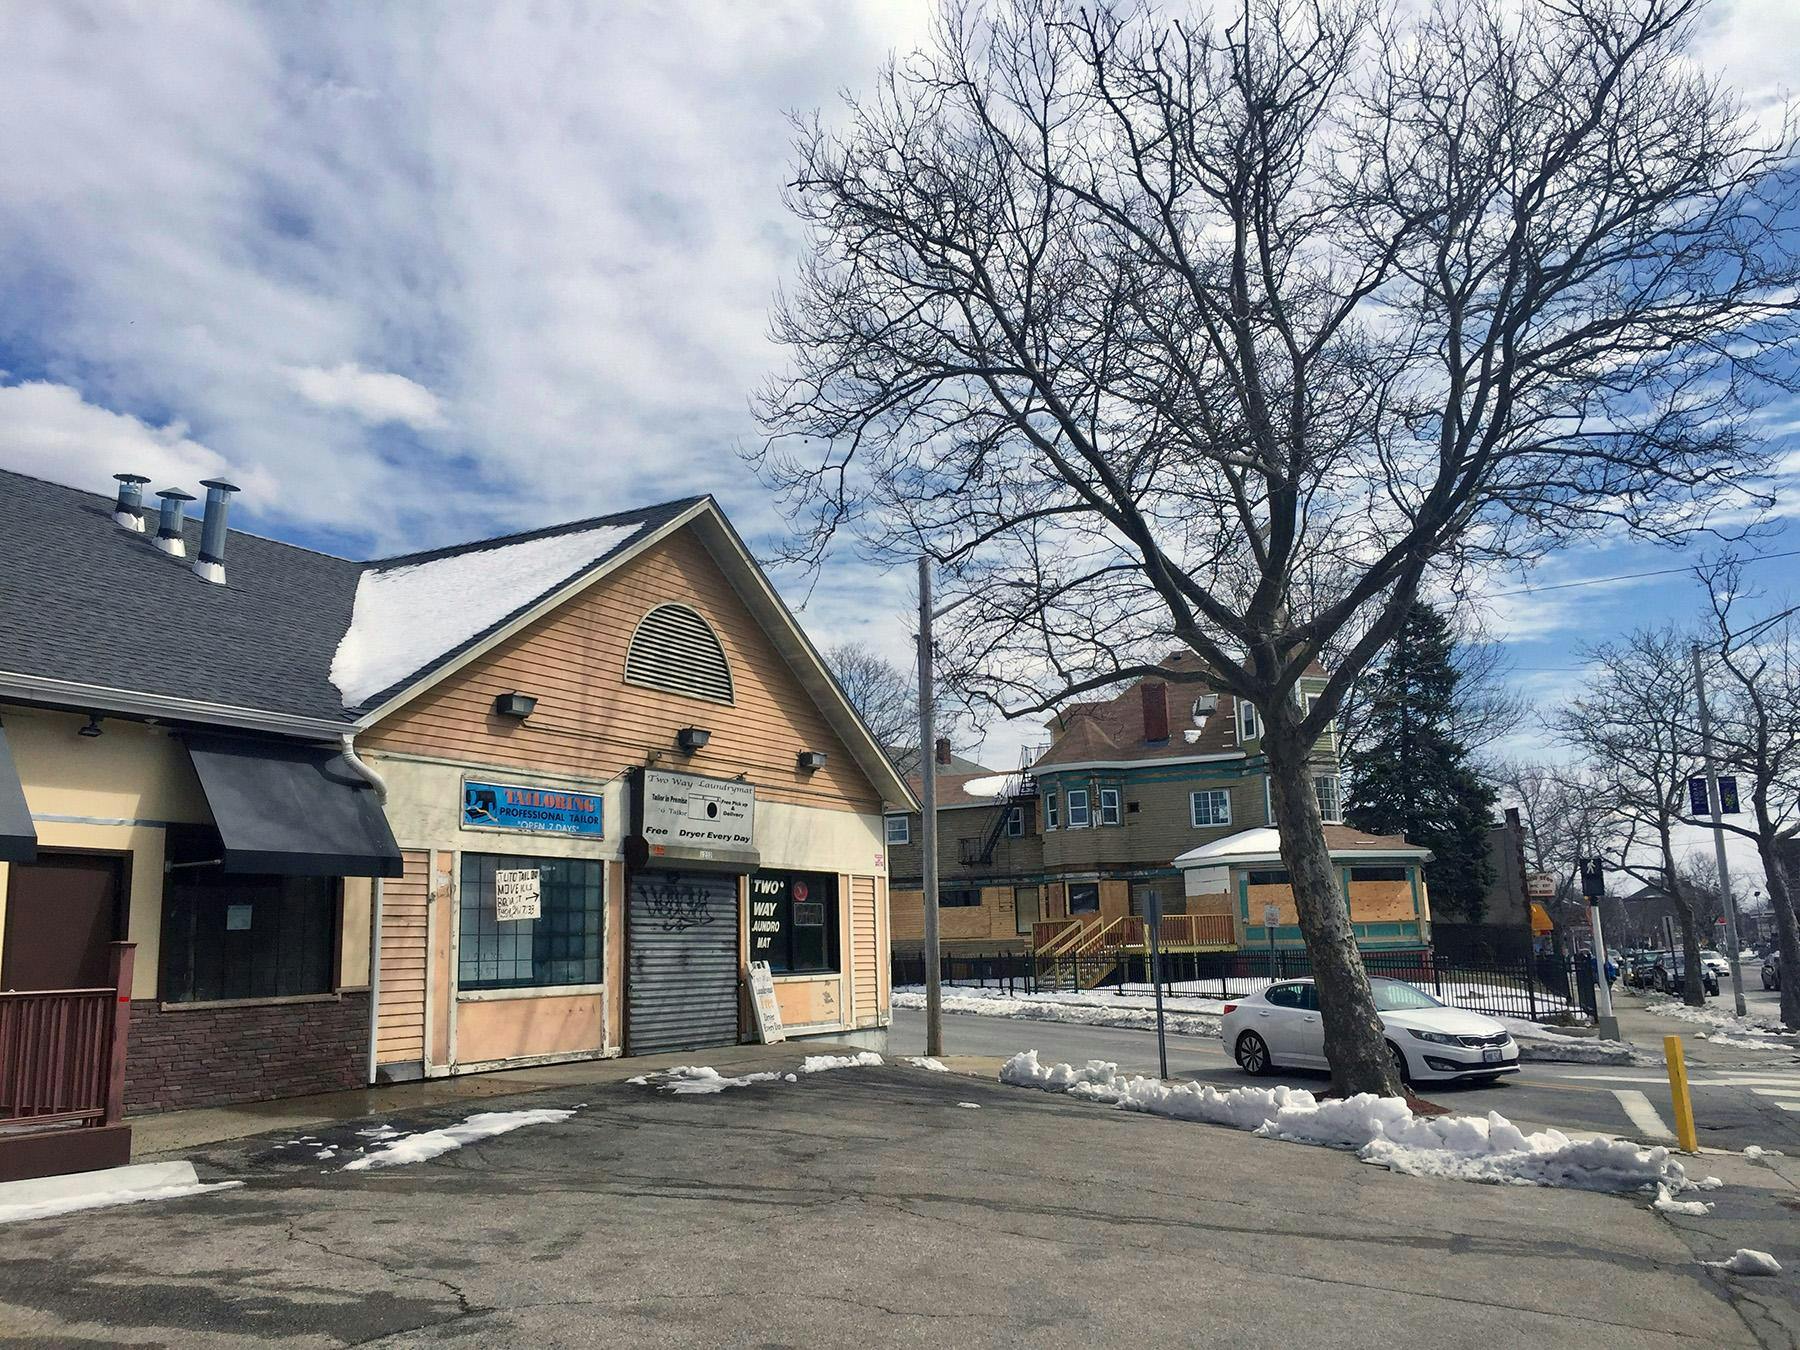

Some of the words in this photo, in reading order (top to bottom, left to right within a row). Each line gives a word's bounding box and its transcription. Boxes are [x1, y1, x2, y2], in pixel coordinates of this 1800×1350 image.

[647, 774, 668, 784] Two
[672, 777, 693, 790] Way
[699, 780, 752, 795] Laundrymat
[504, 789, 595, 813] TAILORING
[500, 807, 564, 822] PROFESSIONAL
[570, 814, 599, 825] TAILOR
[722, 811, 744, 819] Delivery
[646, 826, 668, 836] Free
[679, 830, 705, 839] Dryer
[707, 832, 732, 842] Every
[733, 834, 750, 844] Day
[754, 880, 779, 894] TWO
[753, 902, 777, 916] WAY
[757, 937, 771, 949] MAT
